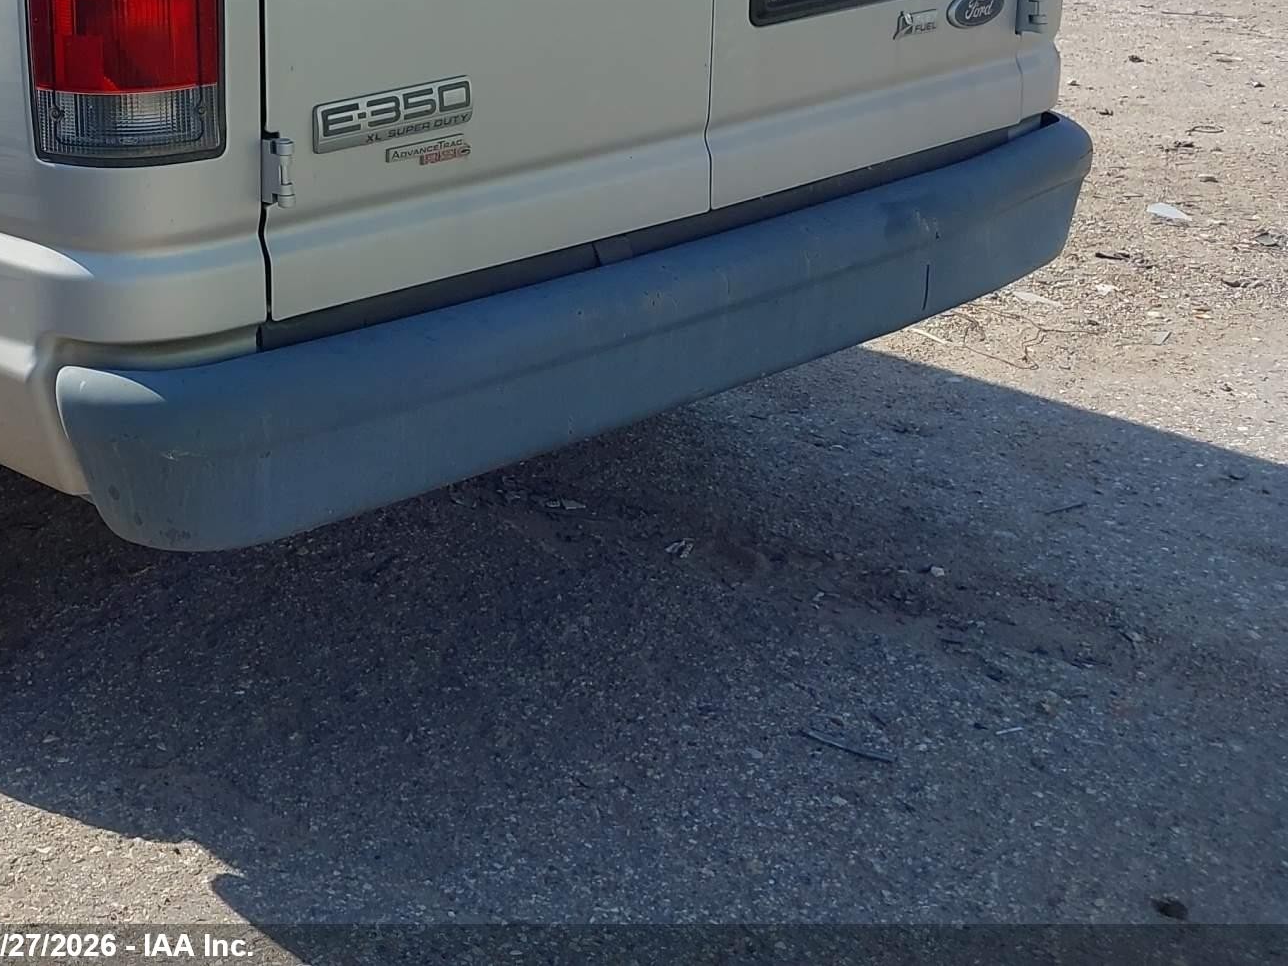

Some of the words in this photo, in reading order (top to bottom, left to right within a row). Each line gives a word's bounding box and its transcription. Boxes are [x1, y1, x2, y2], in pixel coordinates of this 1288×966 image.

[914, 21, 937, 32] FUEL
[321, 80, 471, 137] E-350
[365, 132, 382, 143] XL
[388, 122, 431, 139] SUPER
[434, 113, 469, 128] DUTY
